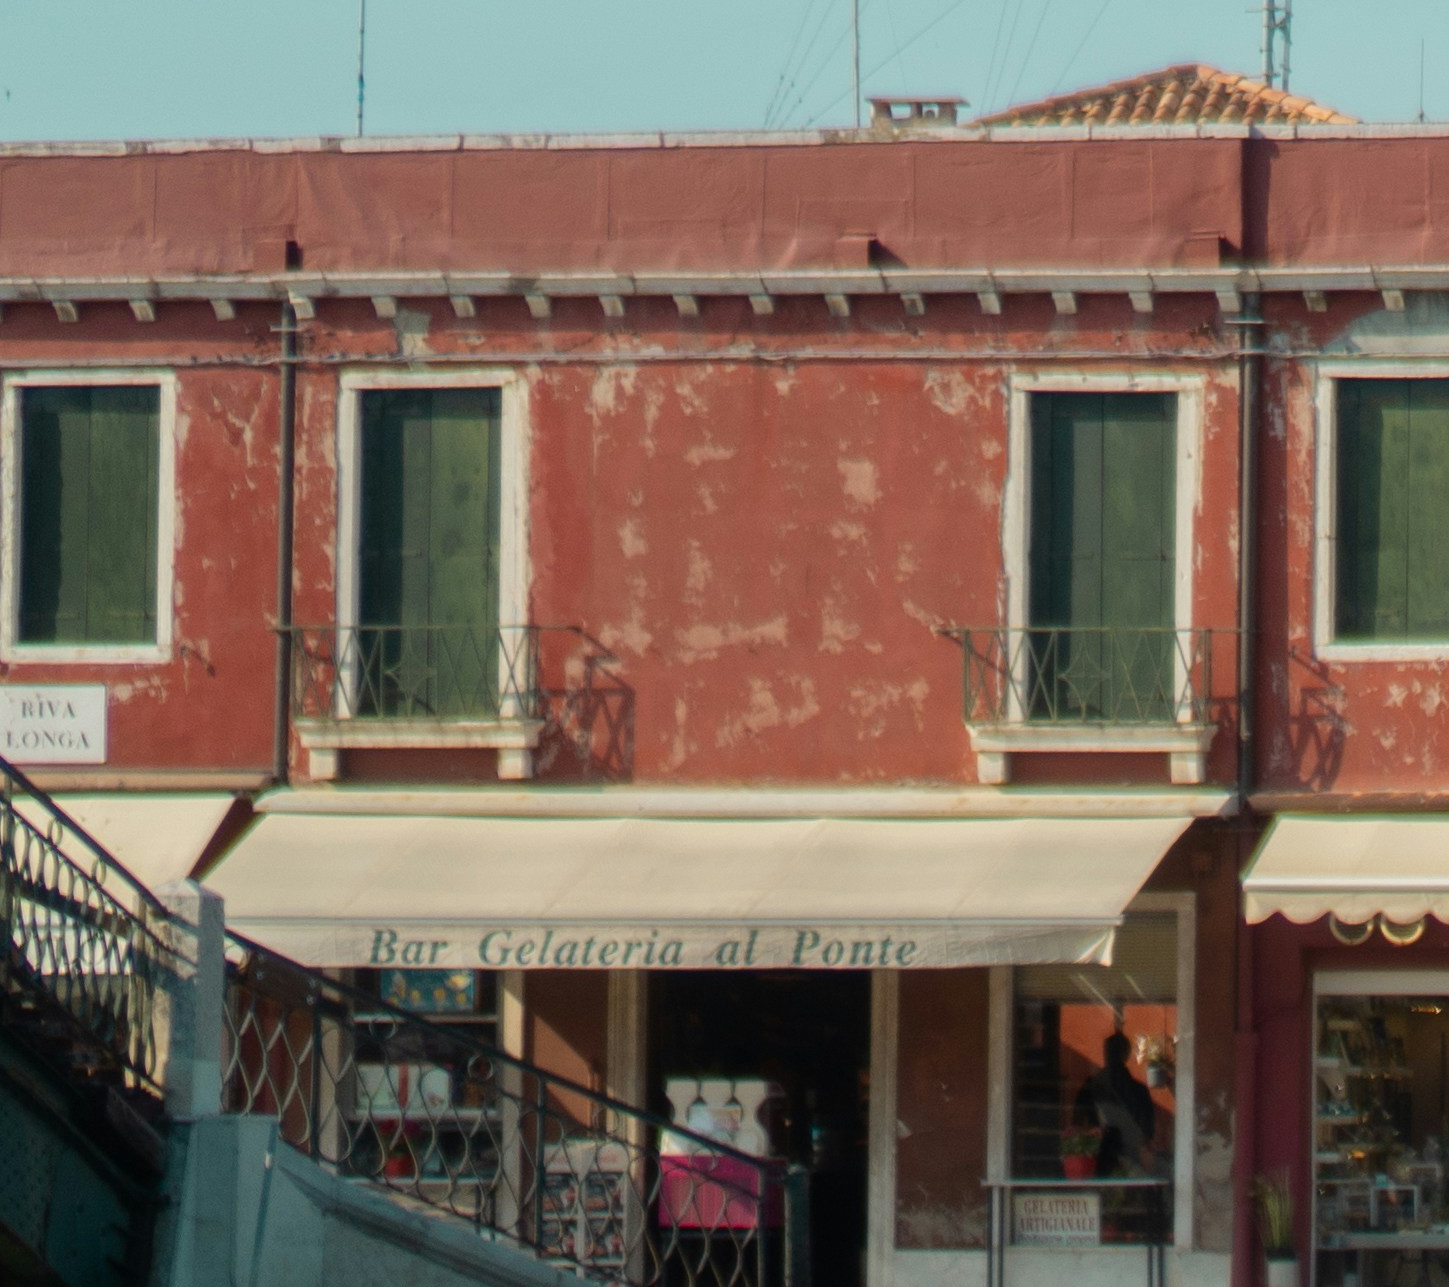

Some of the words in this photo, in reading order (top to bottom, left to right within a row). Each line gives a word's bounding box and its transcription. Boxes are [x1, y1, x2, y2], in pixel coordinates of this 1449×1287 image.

[21, 699, 76, 719] RIVA
[6, 730, 90, 750] LONGA
[368, 928, 449, 966] Bar
[478, 928, 685, 967] Gelateria
[715, 929, 758, 967] al
[790, 928, 918, 967] Ponte
